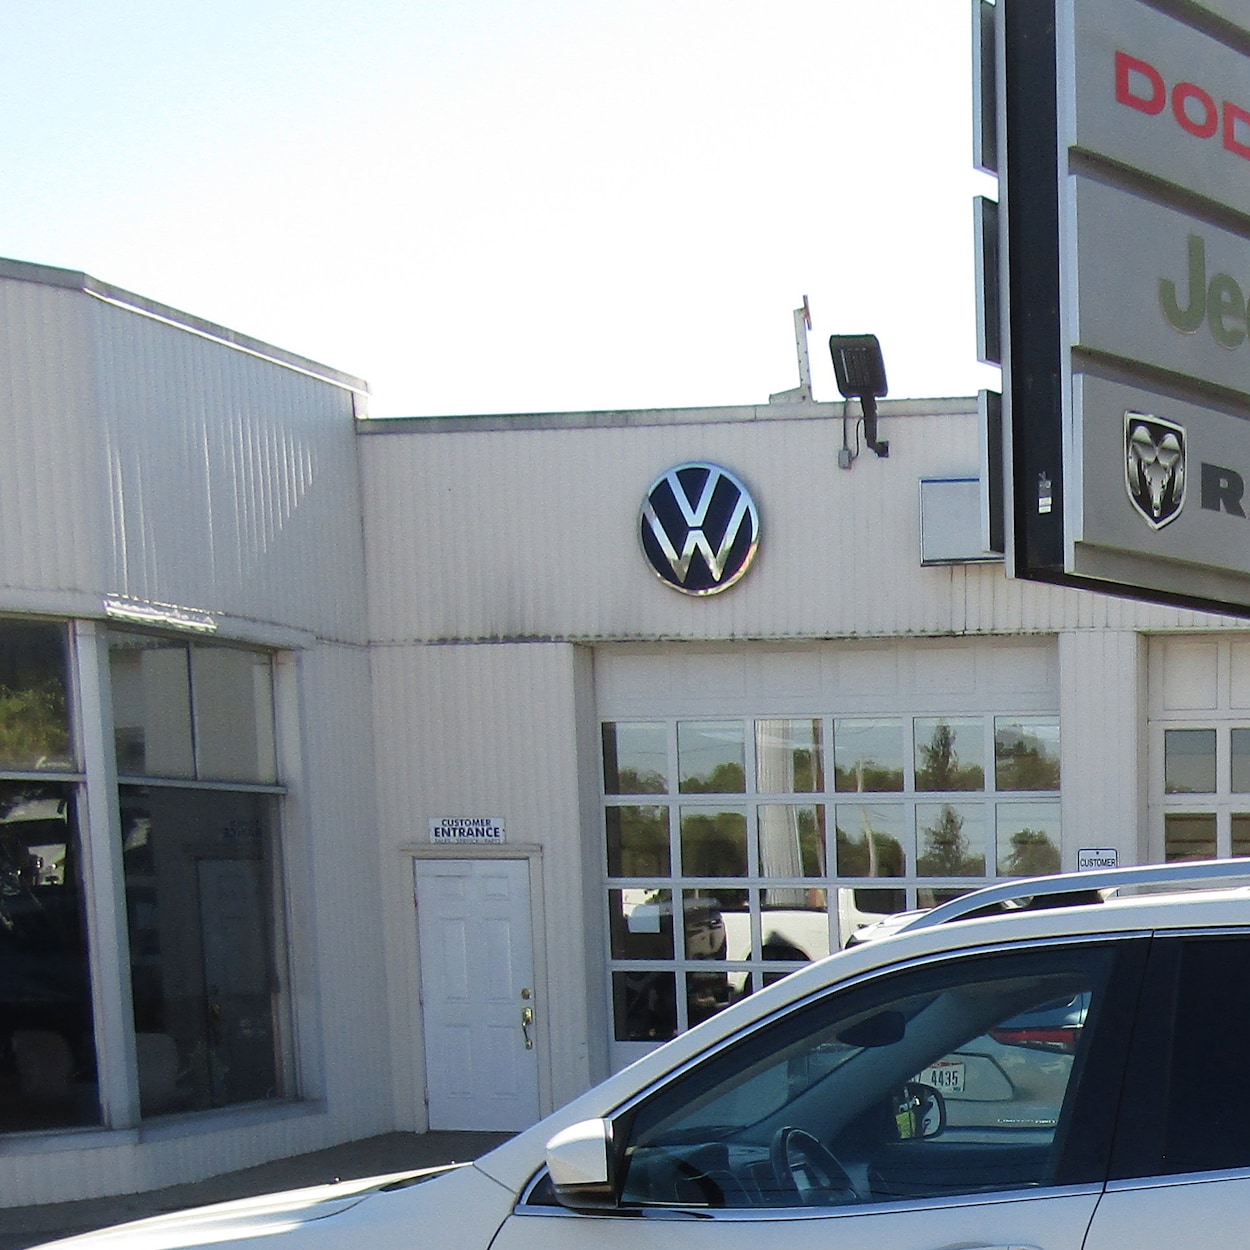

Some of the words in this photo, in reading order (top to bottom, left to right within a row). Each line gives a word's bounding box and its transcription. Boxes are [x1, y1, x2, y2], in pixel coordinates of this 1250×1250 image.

[641, 463, 756, 588] VW
[441, 818, 491, 827] CUSTOMER
[434, 827, 500, 838] ENTRANCE
[1080, 858, 1115, 867] CUSTOMER
[930, 1070, 958, 1087] 4435
